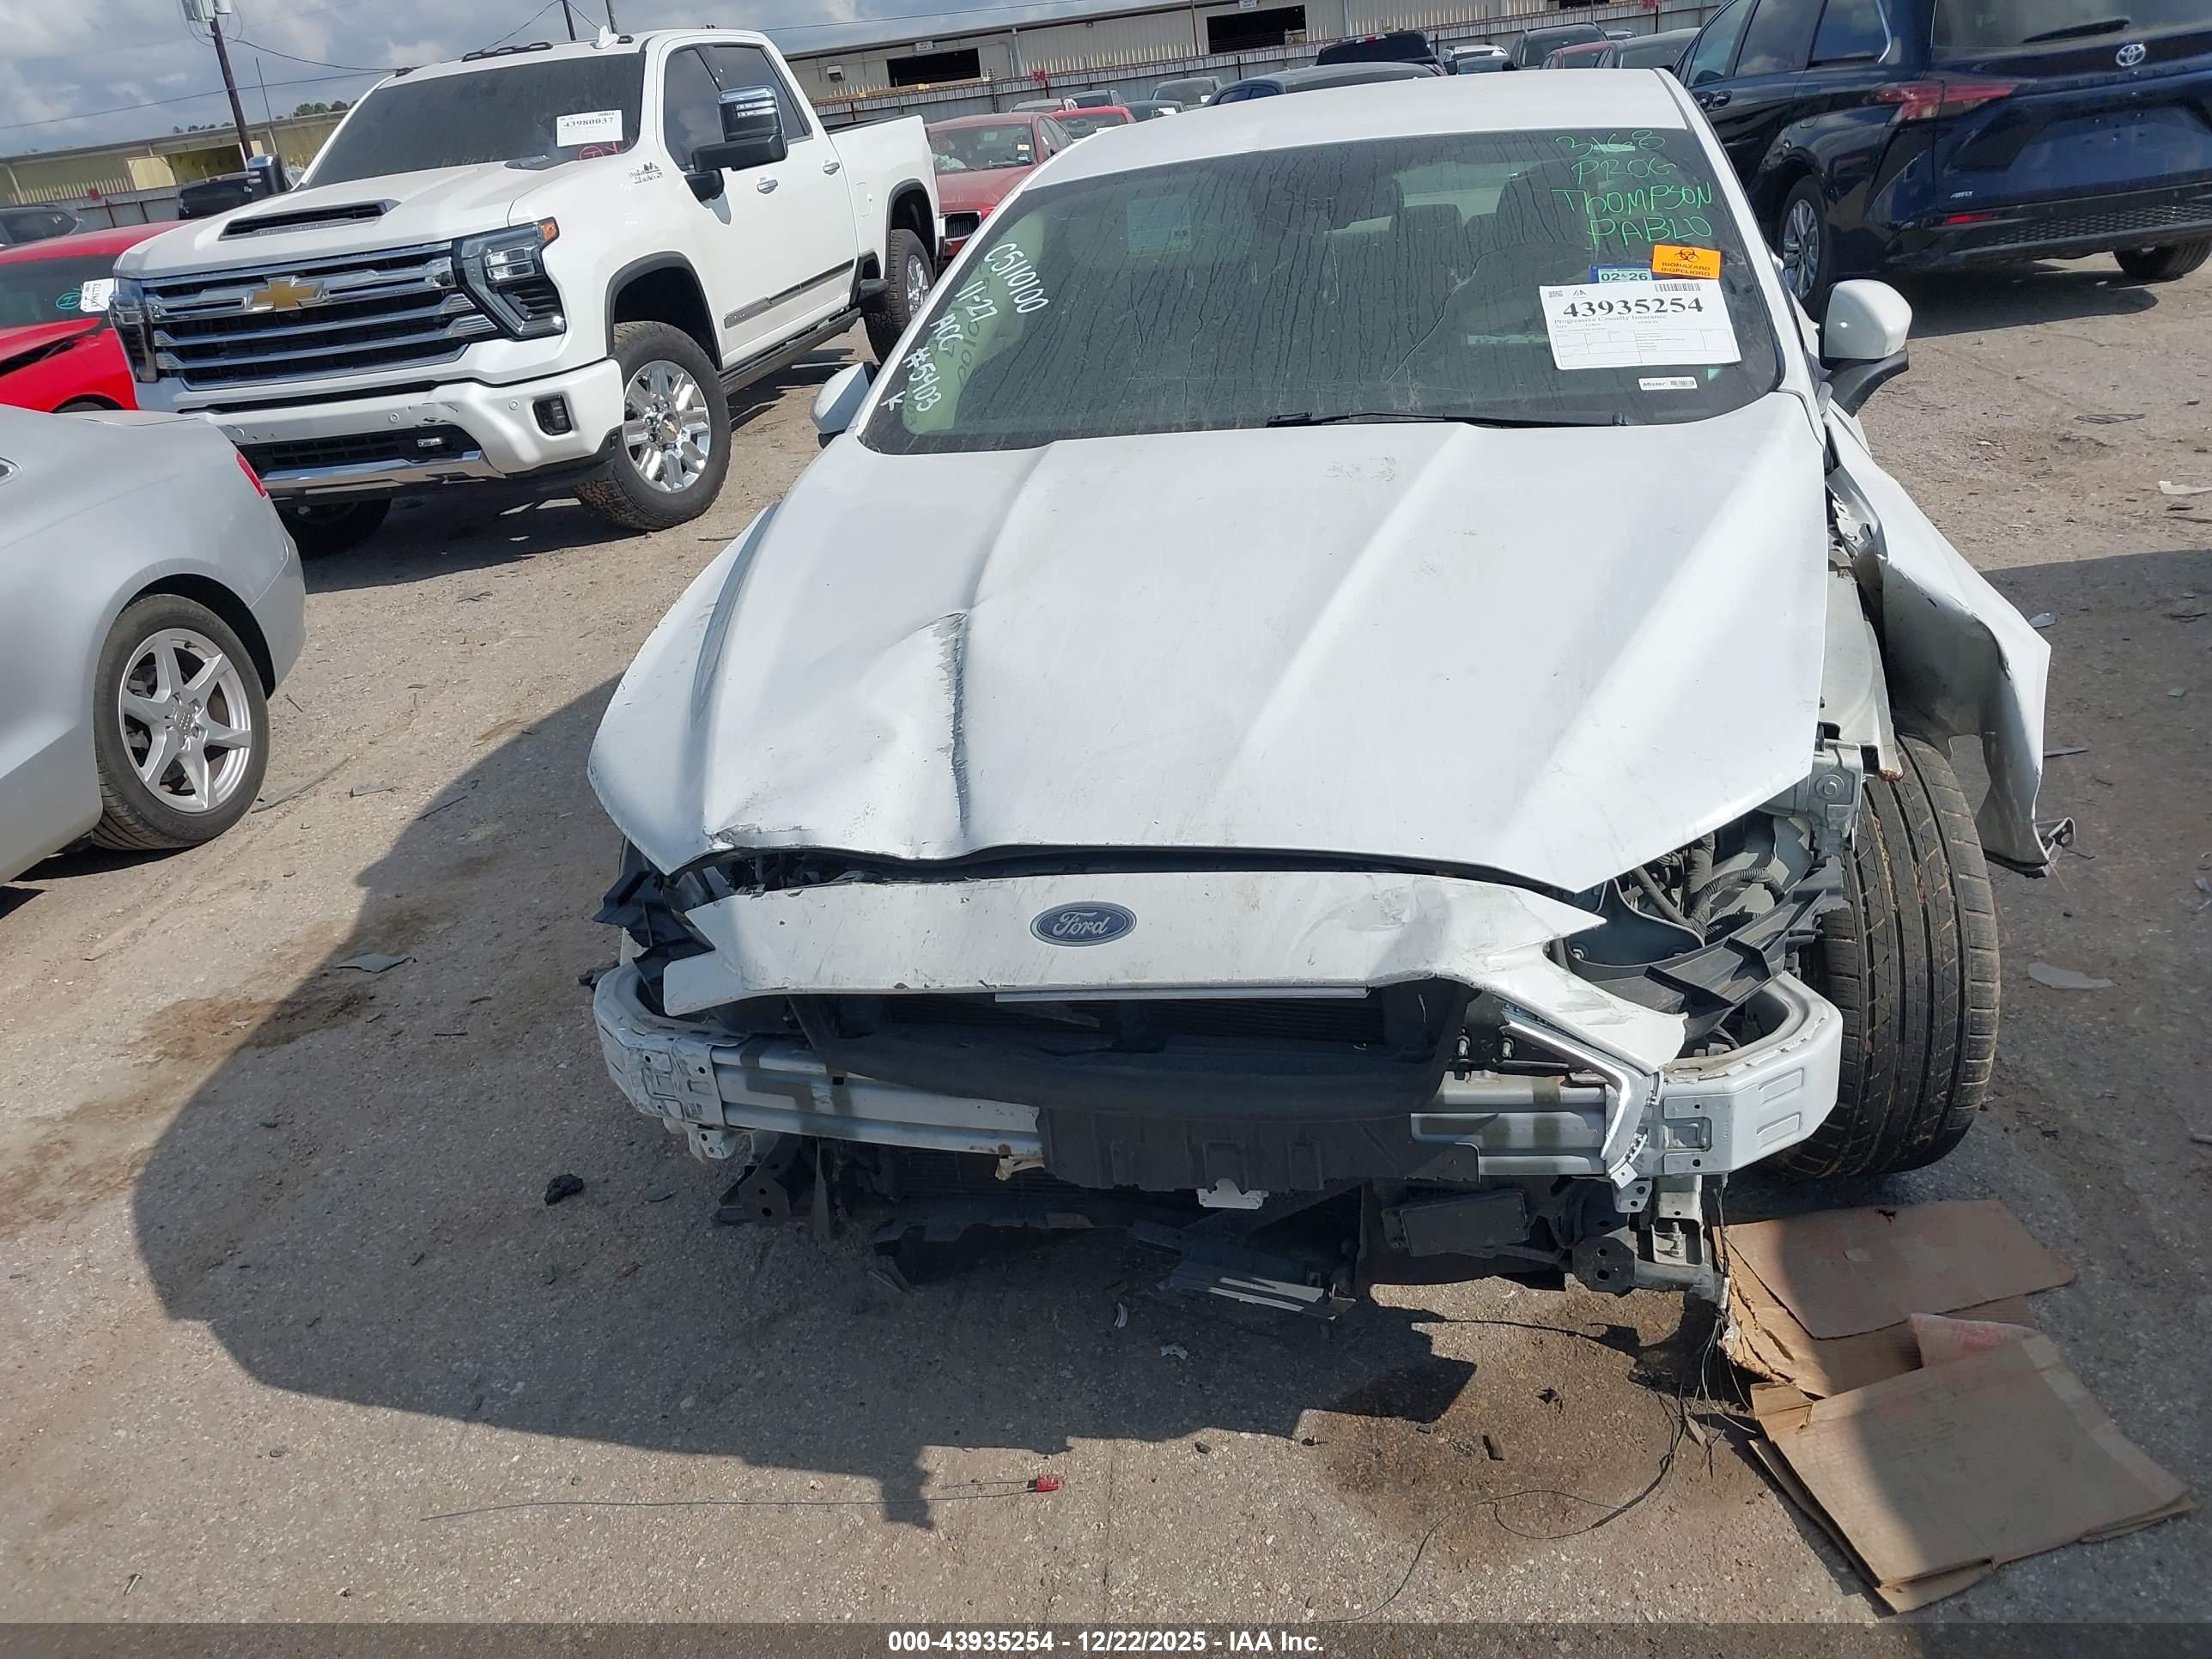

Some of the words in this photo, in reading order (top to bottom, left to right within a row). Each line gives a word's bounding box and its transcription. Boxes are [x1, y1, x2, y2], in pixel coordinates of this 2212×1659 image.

[563, 117, 614, 129] 43980037
[1571, 158, 1677, 185] PROG
[1587, 216, 1712, 246] PABLO
[1662, 261, 1711, 271] BIOHAZARD
[955, 280, 998, 323] 11-27
[1563, 296, 1705, 318] 43935254
[930, 313, 963, 351] ACC
[902, 346, 943, 412] #5403
[1052, 911, 1111, 936] Ford
